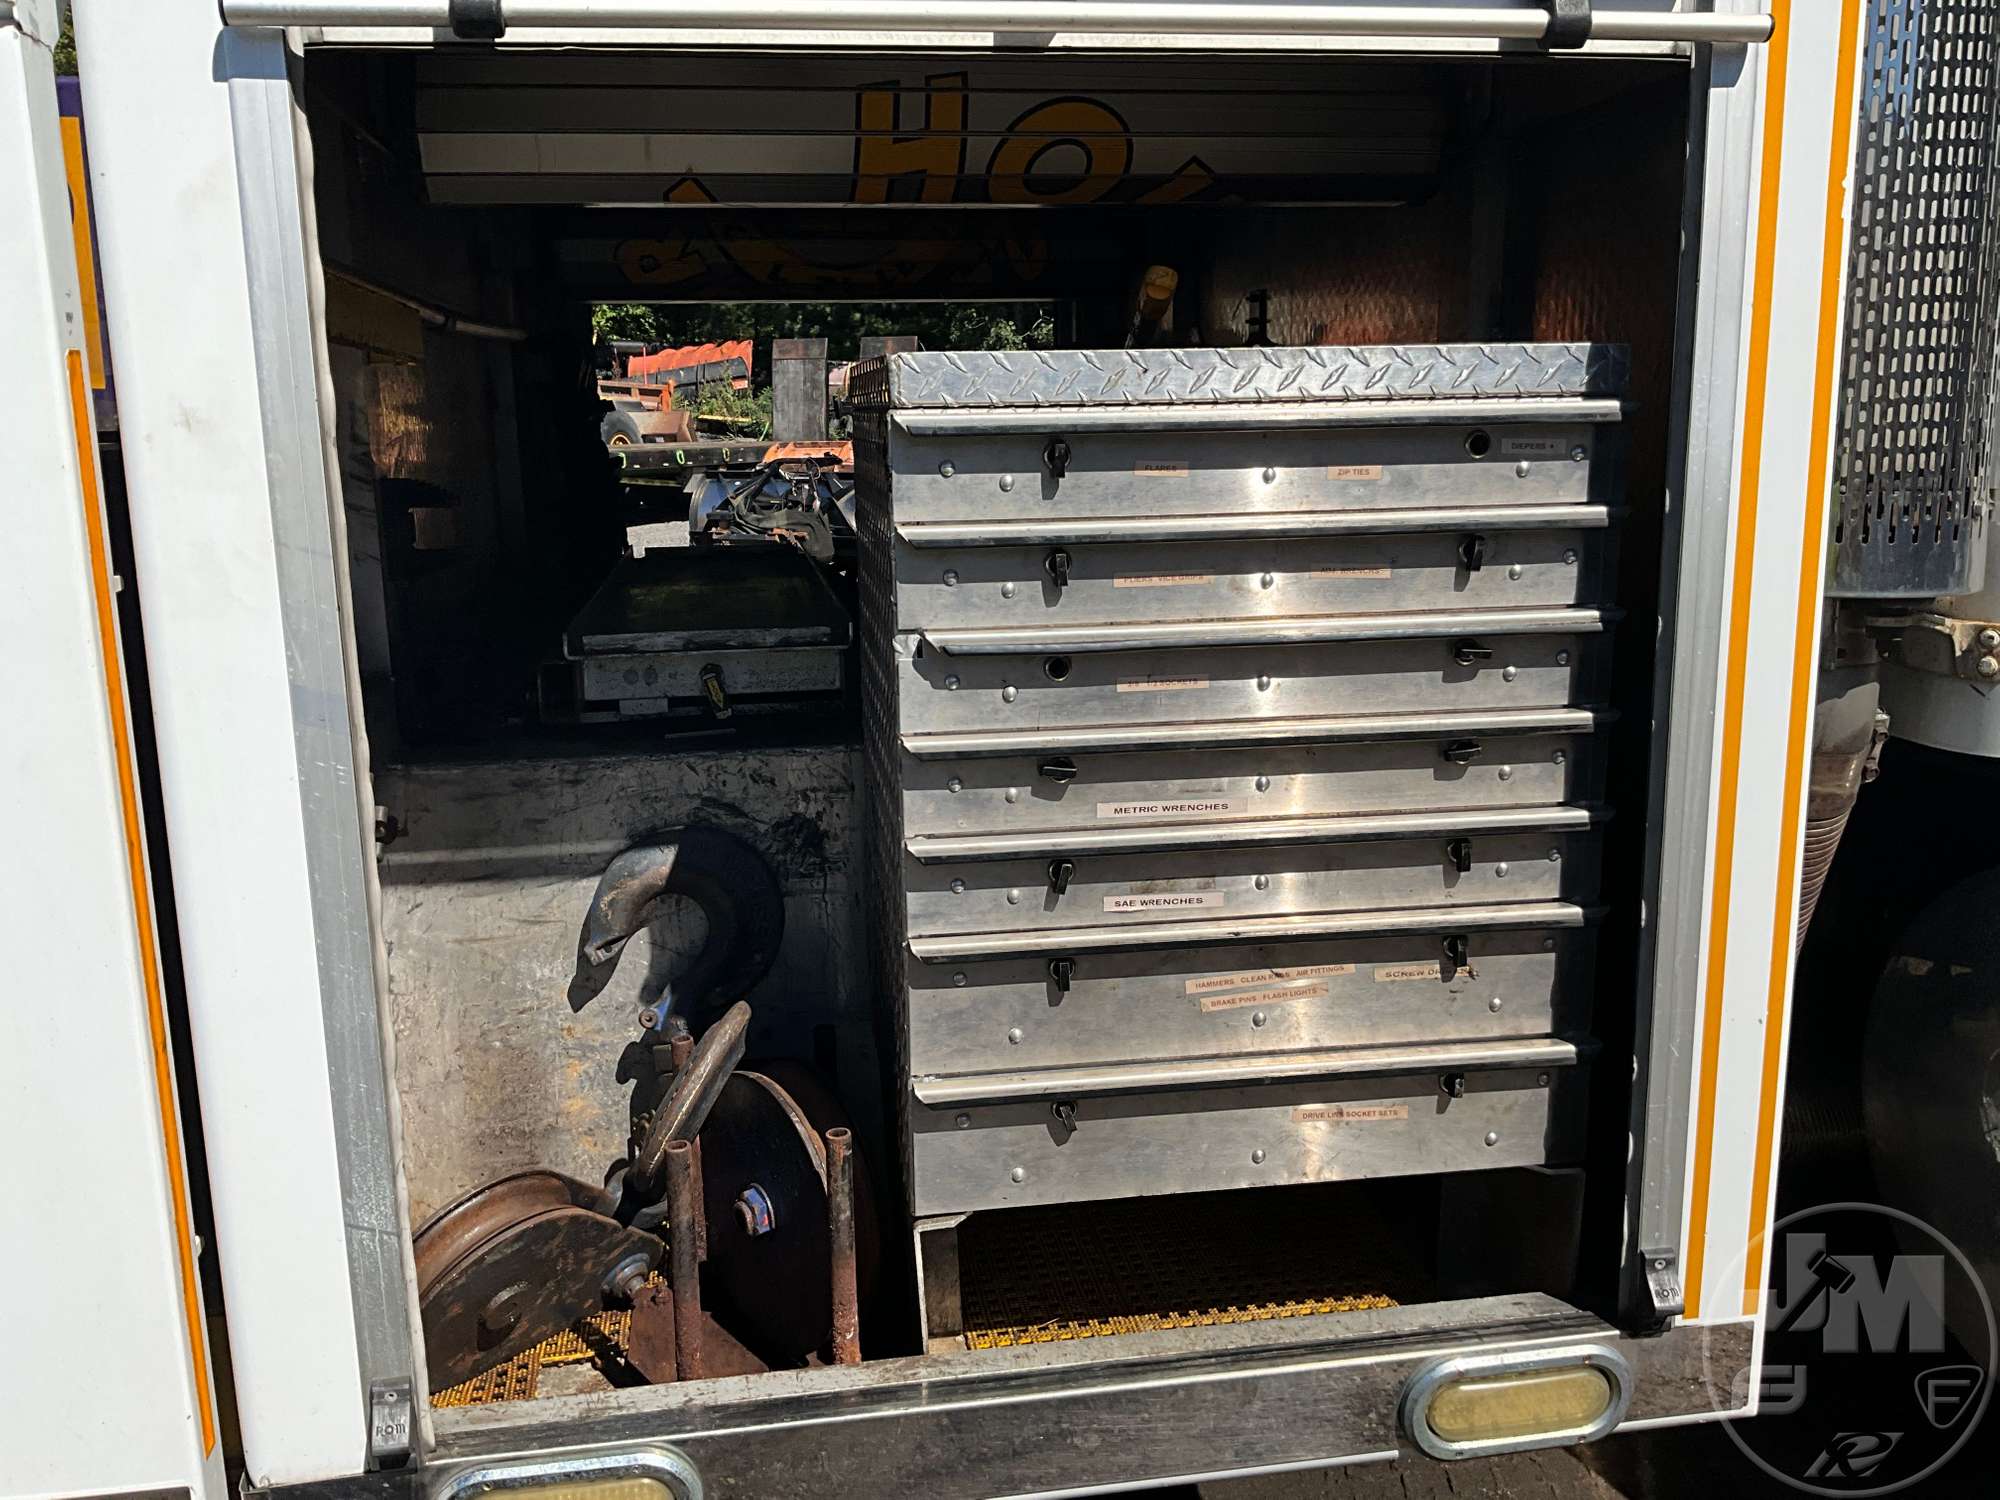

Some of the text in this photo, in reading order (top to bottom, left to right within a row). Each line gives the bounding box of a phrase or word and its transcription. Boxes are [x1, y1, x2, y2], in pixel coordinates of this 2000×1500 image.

[1352, 468, 1370, 476] TIES
[1113, 803, 1229, 815] METRIC WRENCHES
[1140, 897, 1204, 906] WRENCHES
[1195, 978, 1235, 989] HAMMERS
[1240, 974, 1266, 984] CLEAN
[1296, 969, 1308, 977] AIR
[1310, 966, 1345, 976] FITTINGS
[1385, 970, 1424, 978] SCREW
[1210, 987, 1318, 1008] BRAKE PINS FLASH LIGHTS
[1302, 1112, 1325, 1120] DRIVE
[1346, 1110, 1376, 1118] SOCKET
